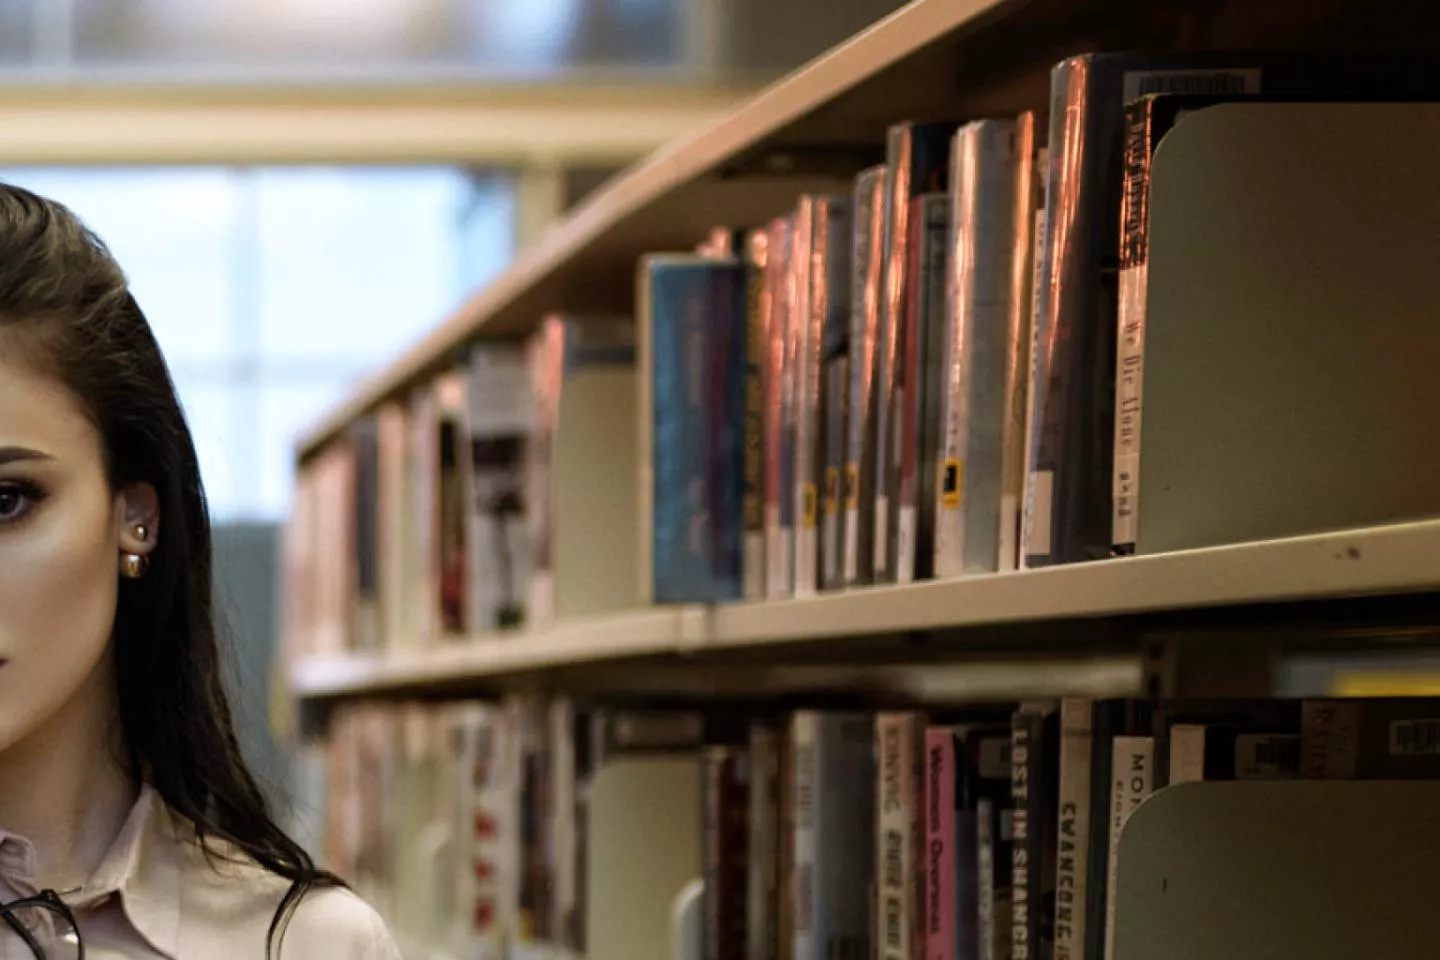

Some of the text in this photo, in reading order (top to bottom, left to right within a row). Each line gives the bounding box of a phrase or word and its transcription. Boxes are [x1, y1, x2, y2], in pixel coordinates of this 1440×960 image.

[929, 746, 944, 833] Women
[1012, 729, 1029, 799] LOST
[1012, 809, 1029, 841] IN
